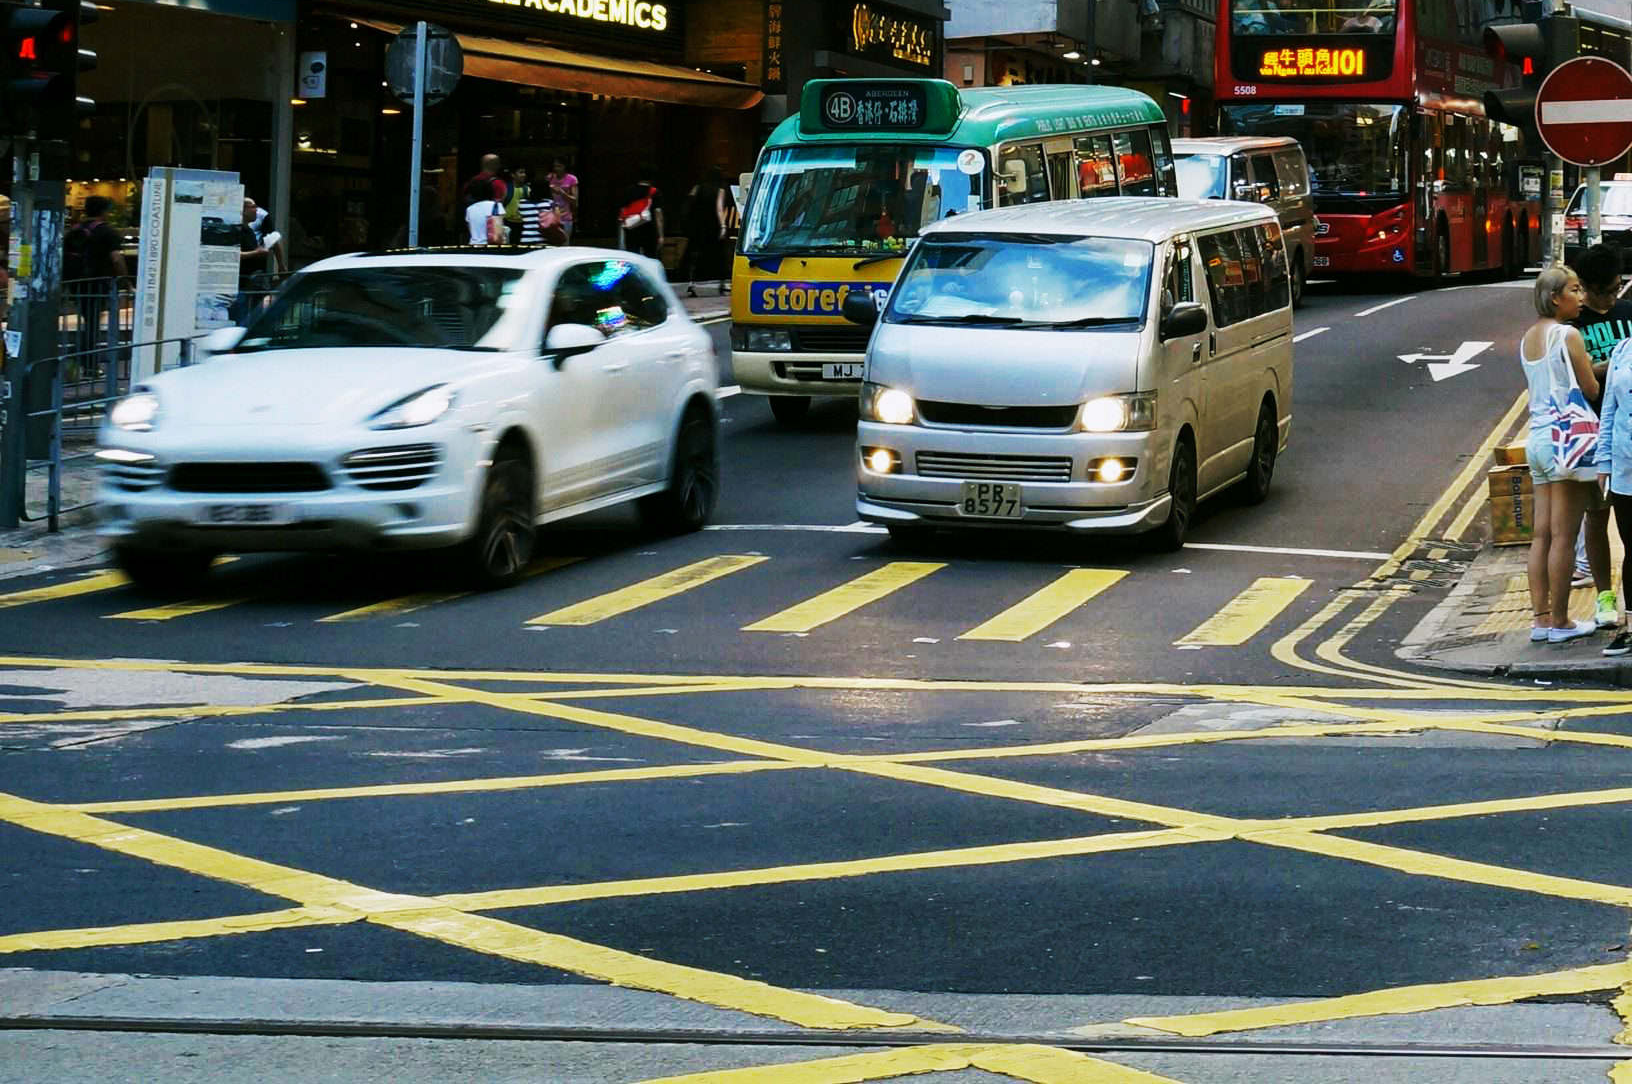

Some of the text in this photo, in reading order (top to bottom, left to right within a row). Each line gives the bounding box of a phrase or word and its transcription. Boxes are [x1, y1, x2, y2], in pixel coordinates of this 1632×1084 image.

[1263, 49, 1363, 75] 經牛頭角 101
[865, 89, 910, 98] ABERDEEN
[1234, 85, 1257, 95] 5508
[830, 97, 851, 118] 4B
[833, 365, 853, 377] MJ
[964, 498, 1018, 516] 8577
